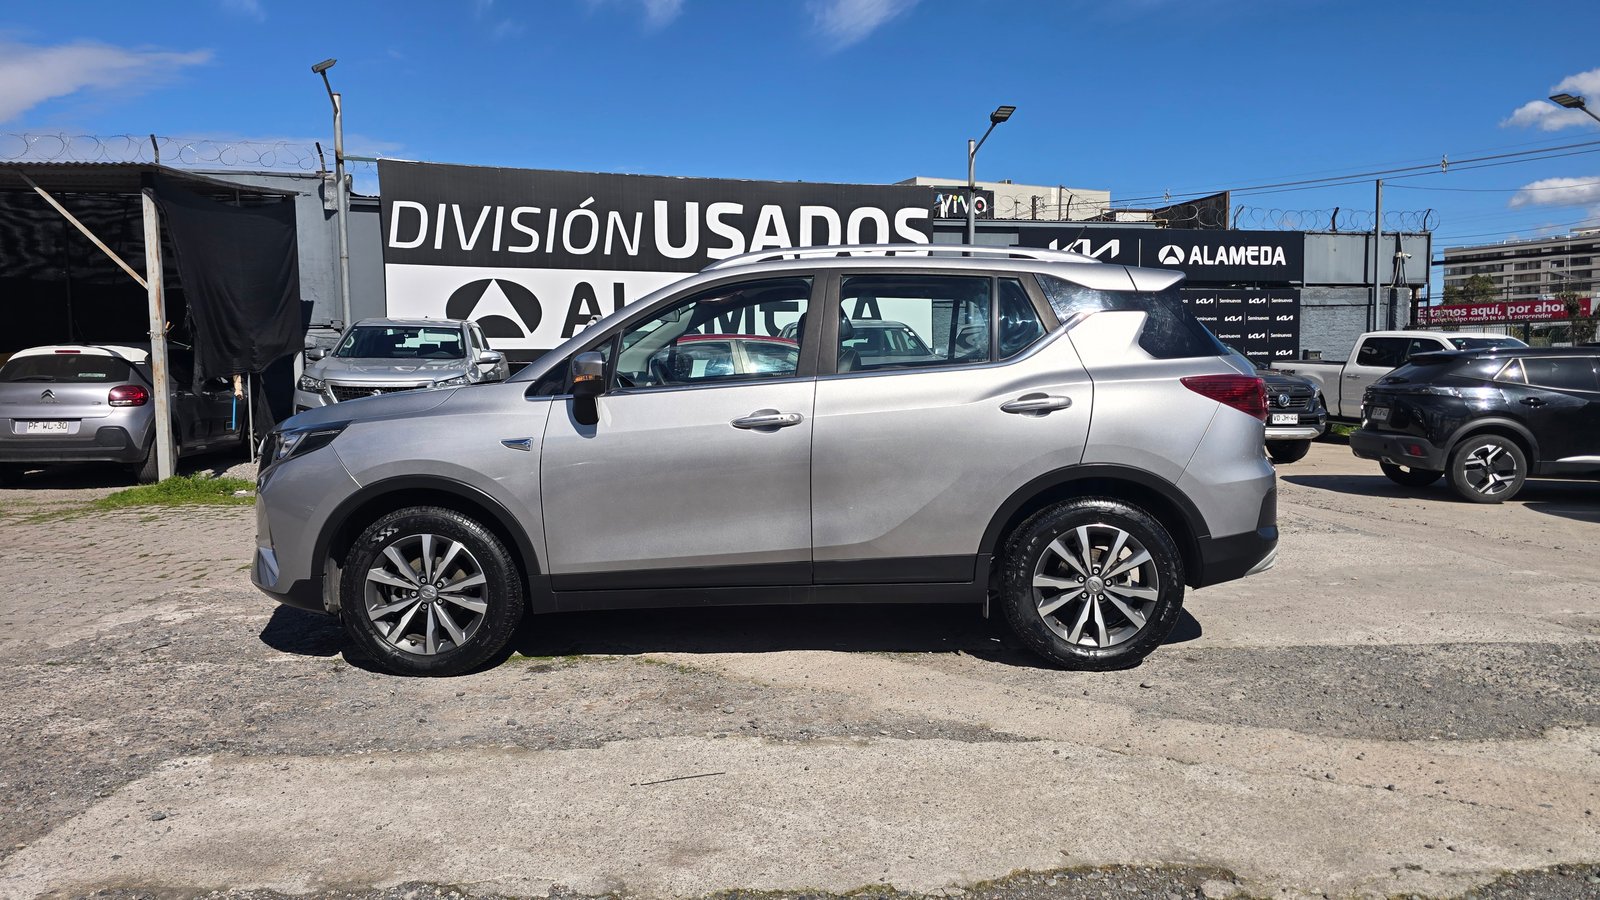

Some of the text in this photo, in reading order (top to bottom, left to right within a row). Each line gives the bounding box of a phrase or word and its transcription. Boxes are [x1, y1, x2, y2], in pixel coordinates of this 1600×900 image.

[388, 196, 929, 259] DIVISIÓN USADOS
[1188, 245, 1287, 266] ALAMEDA
[1471, 304, 1501, 317] aquí,
[1507, 303, 1531, 316] por
